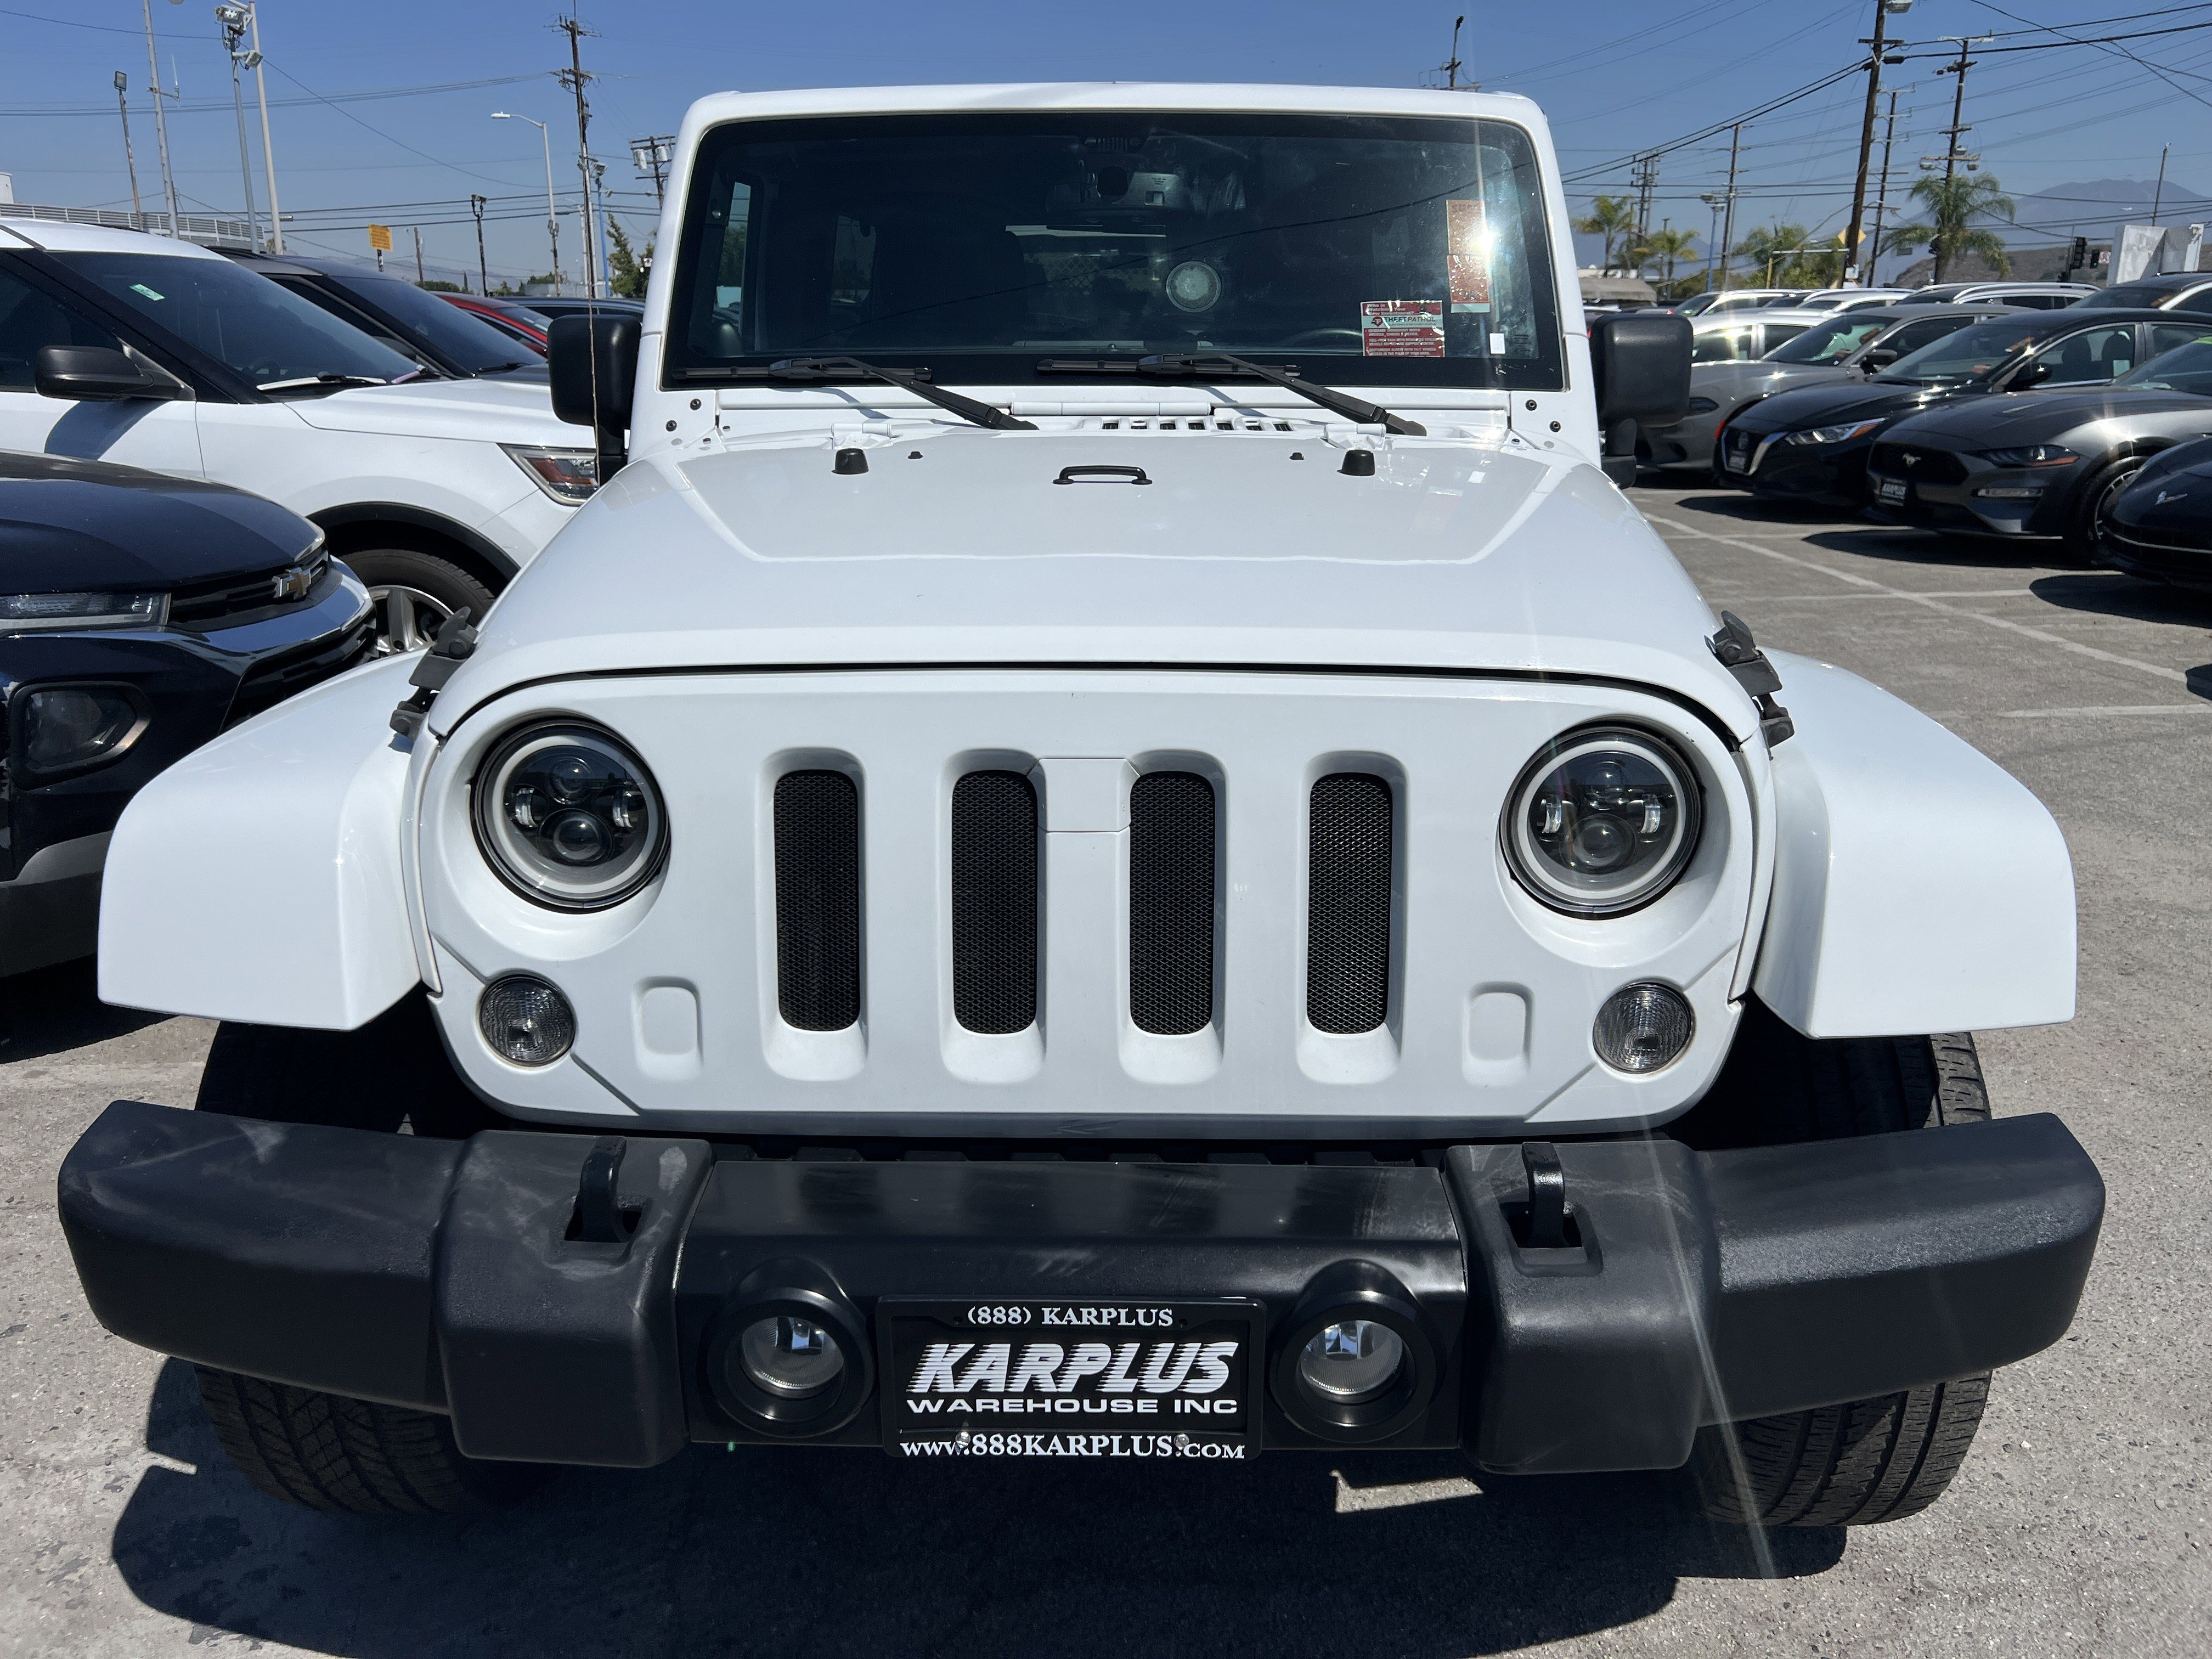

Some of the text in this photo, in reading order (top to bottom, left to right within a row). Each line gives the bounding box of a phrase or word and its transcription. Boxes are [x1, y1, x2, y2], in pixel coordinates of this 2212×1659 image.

[968, 1306, 1173, 1327] (888) KARPLUS
[906, 1341, 1239, 1393] KARPLUS
[906, 1398, 1237, 1414] WAREHOUSE INC
